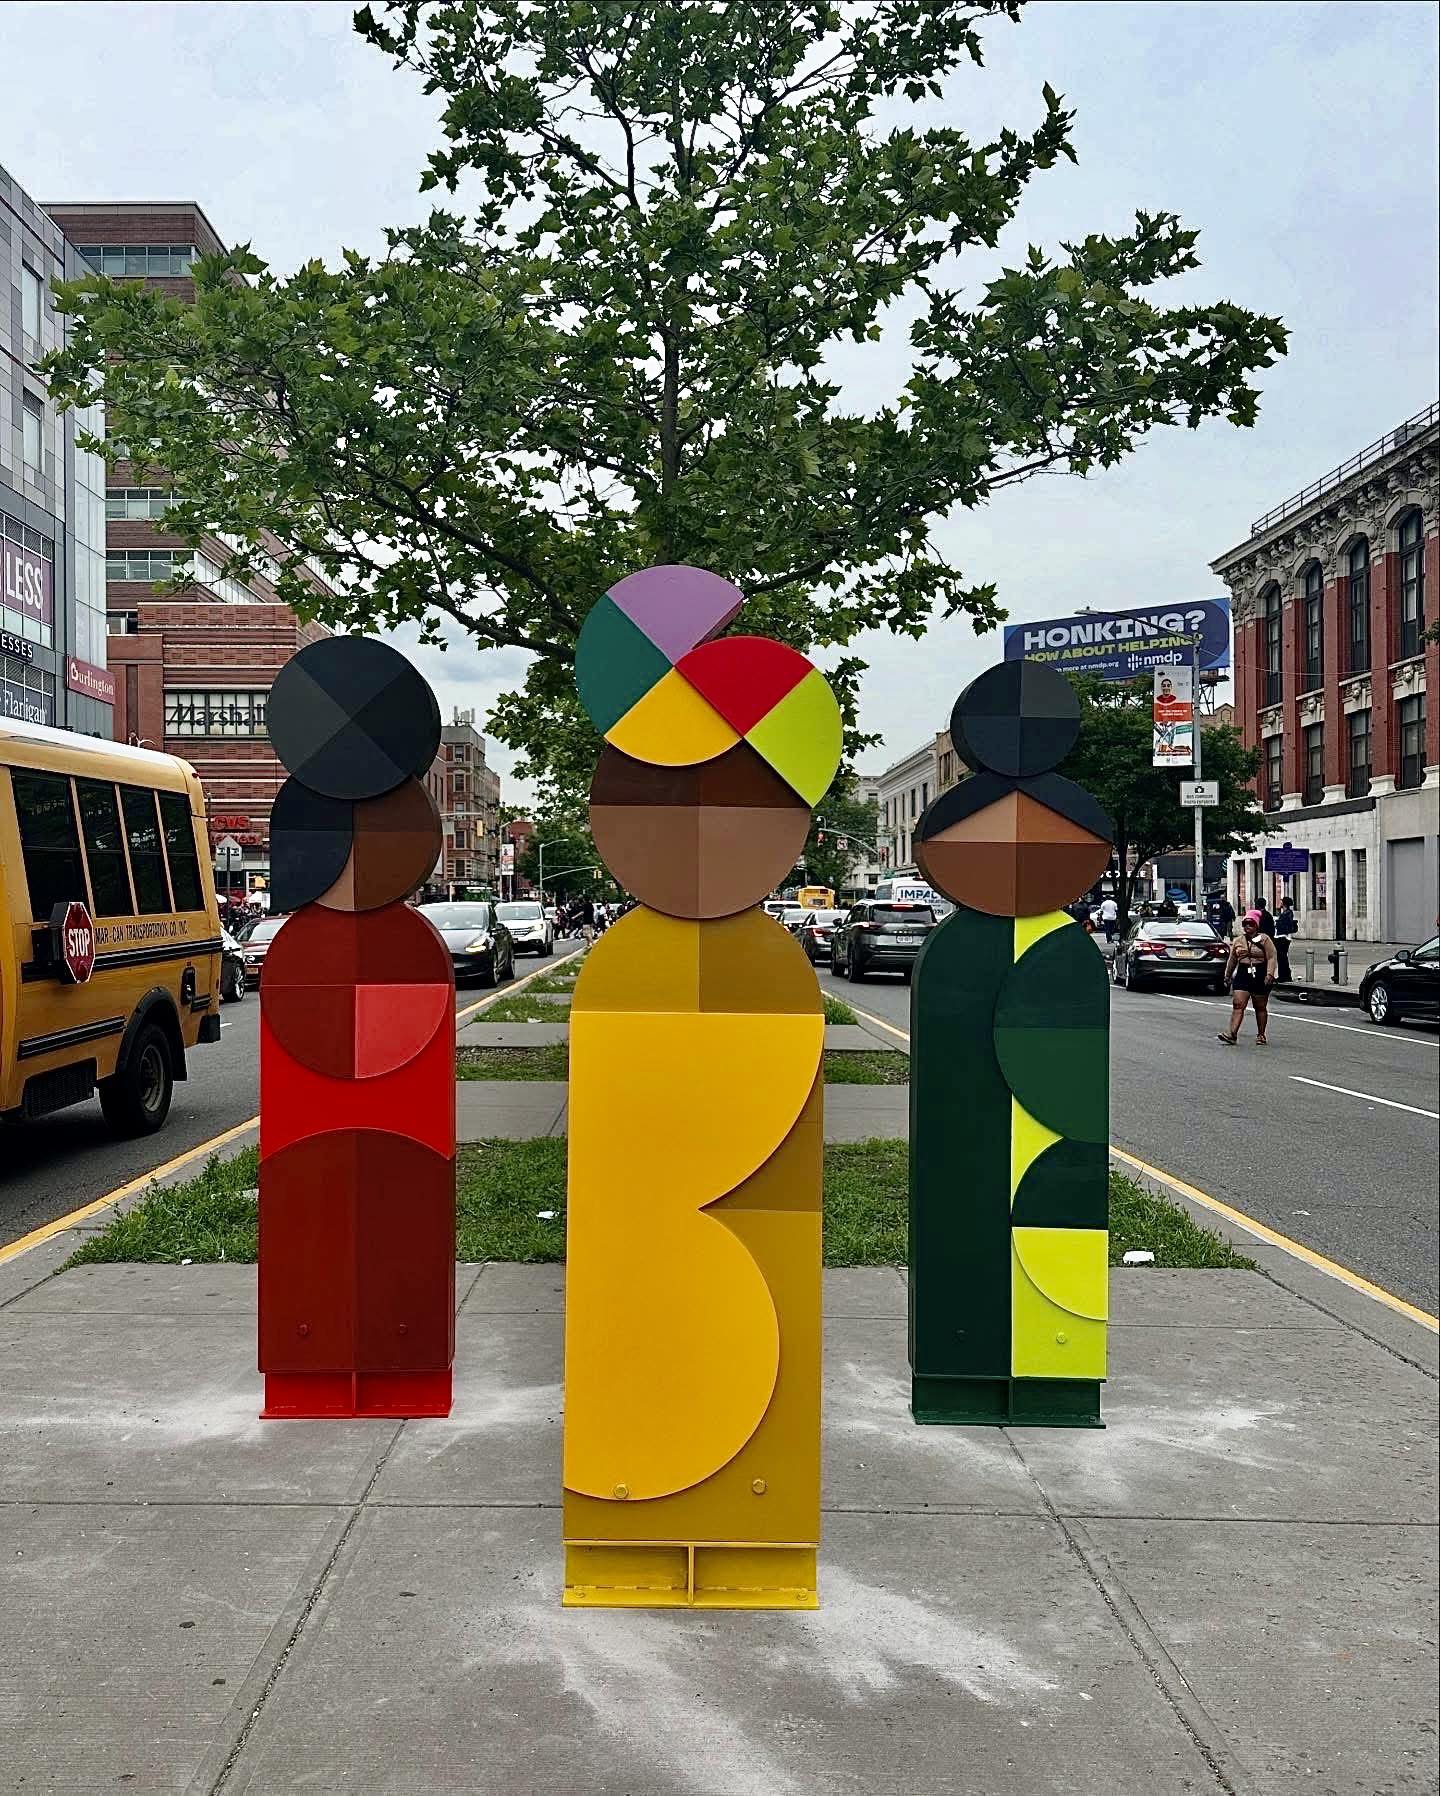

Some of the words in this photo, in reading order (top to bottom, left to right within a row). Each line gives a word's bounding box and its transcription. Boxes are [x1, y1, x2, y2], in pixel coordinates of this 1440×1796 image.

[7, 552, 44, 610] LESS
[1024, 609, 1206, 651] HONKING?
[1024, 651, 1060, 663] HOW
[1061, 644, 1117, 660] ABOUT
[1143, 650, 1183, 666] nmdp
[70, 662, 114, 697] Burlington
[69, 928, 90, 957] STOP
